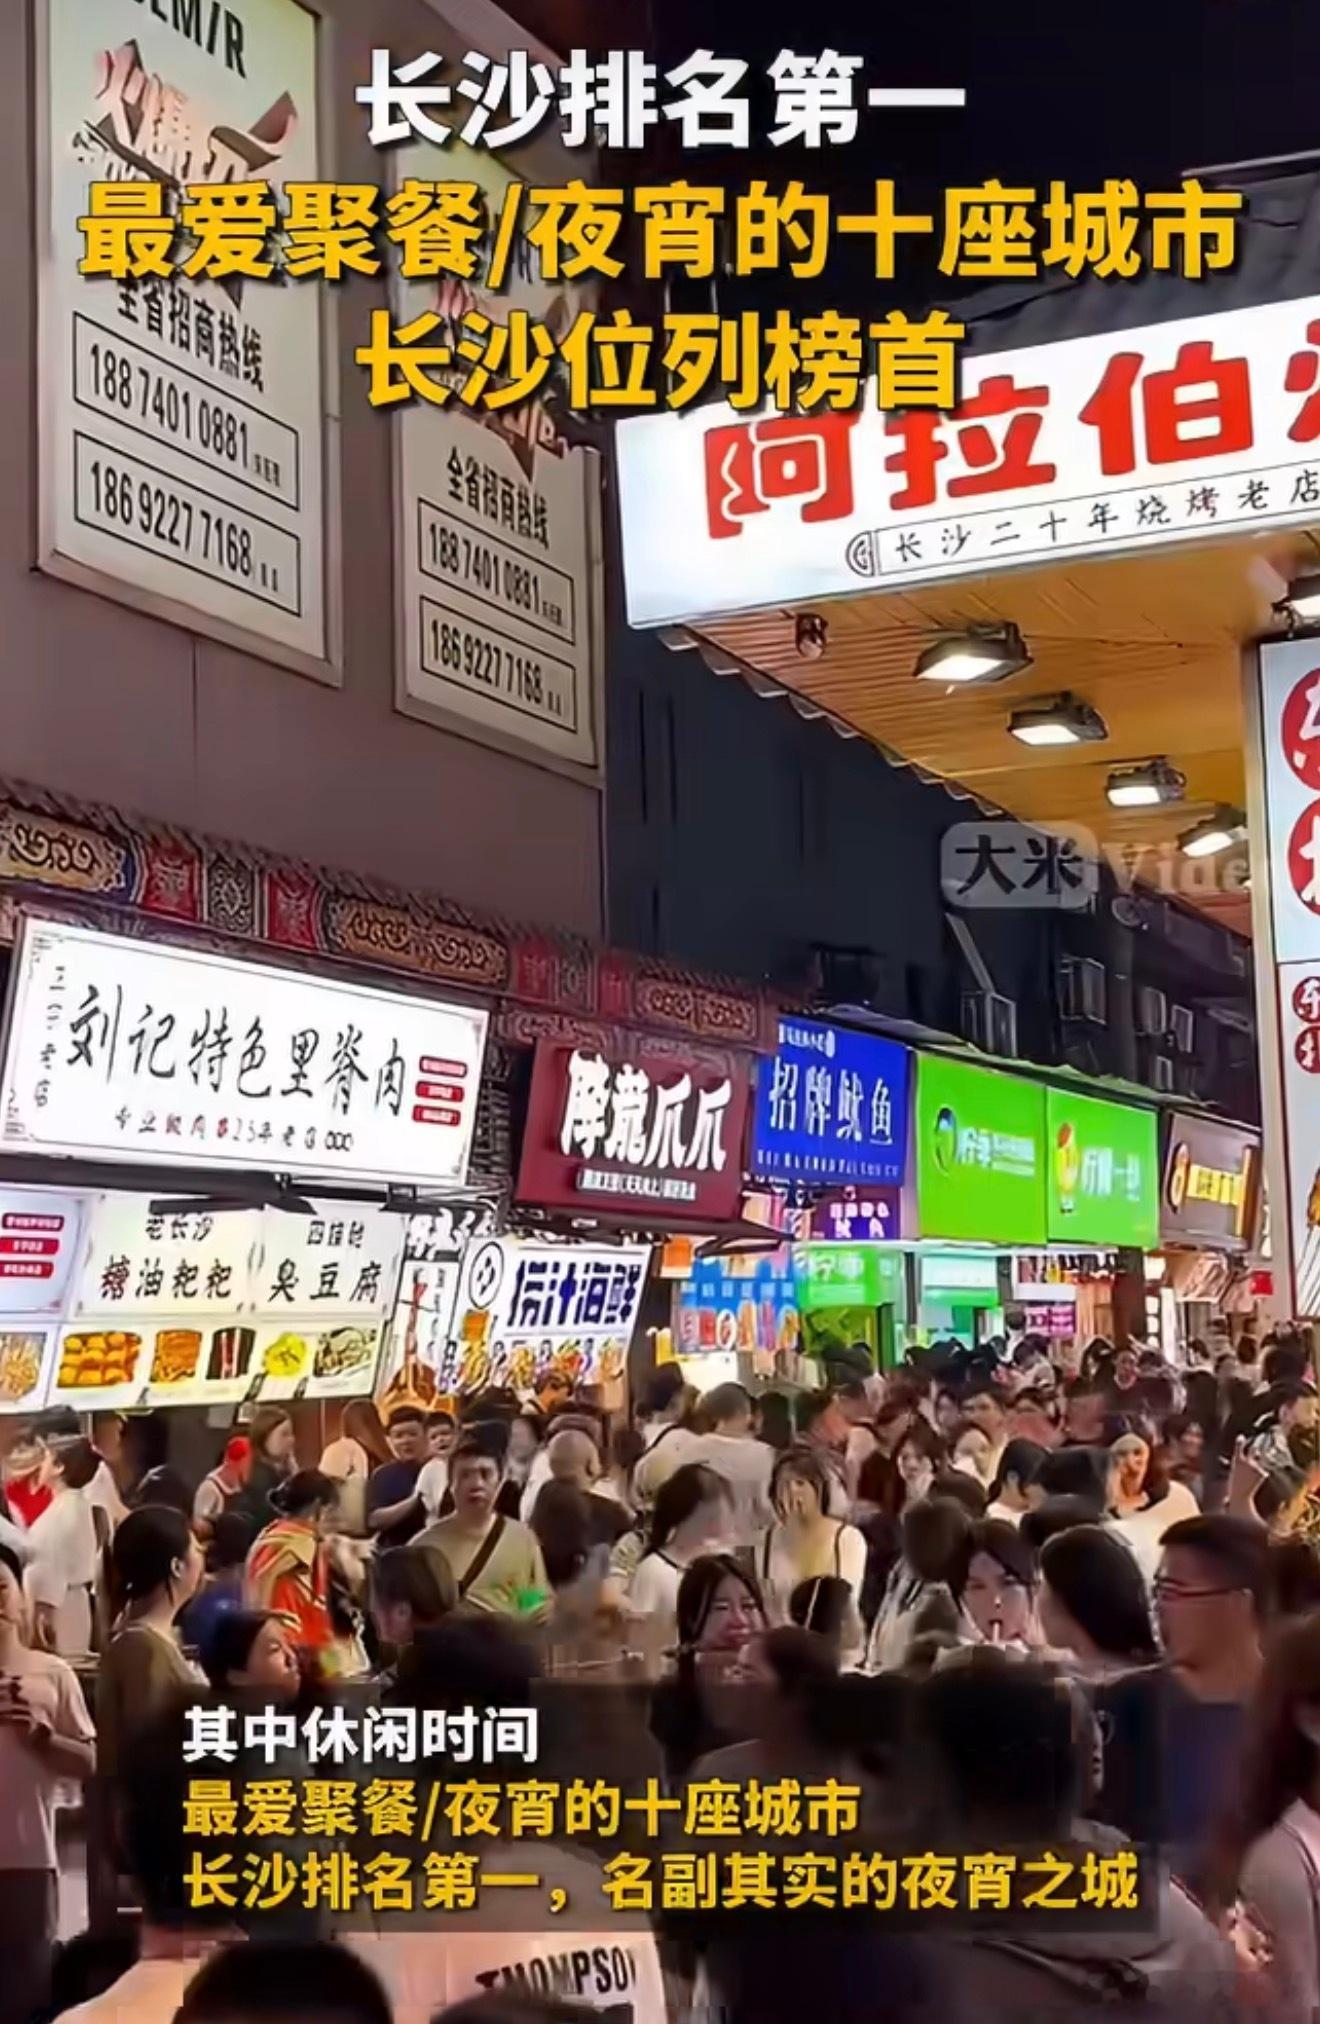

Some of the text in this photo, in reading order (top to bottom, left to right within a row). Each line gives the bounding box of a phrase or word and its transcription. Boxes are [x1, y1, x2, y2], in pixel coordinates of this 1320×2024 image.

[90, 343, 249, 470] 188 7401 0881
[90, 460, 133, 526] 186
[138, 481, 193, 553] 9227
[199, 508, 252, 578] 7168
[895, 470, 1320, 564] 长沙二十年烧烤老店
[66, 983, 407, 1117] 刘记特色里脊肉
[267, 1257, 383, 1304] 臭豆腐
